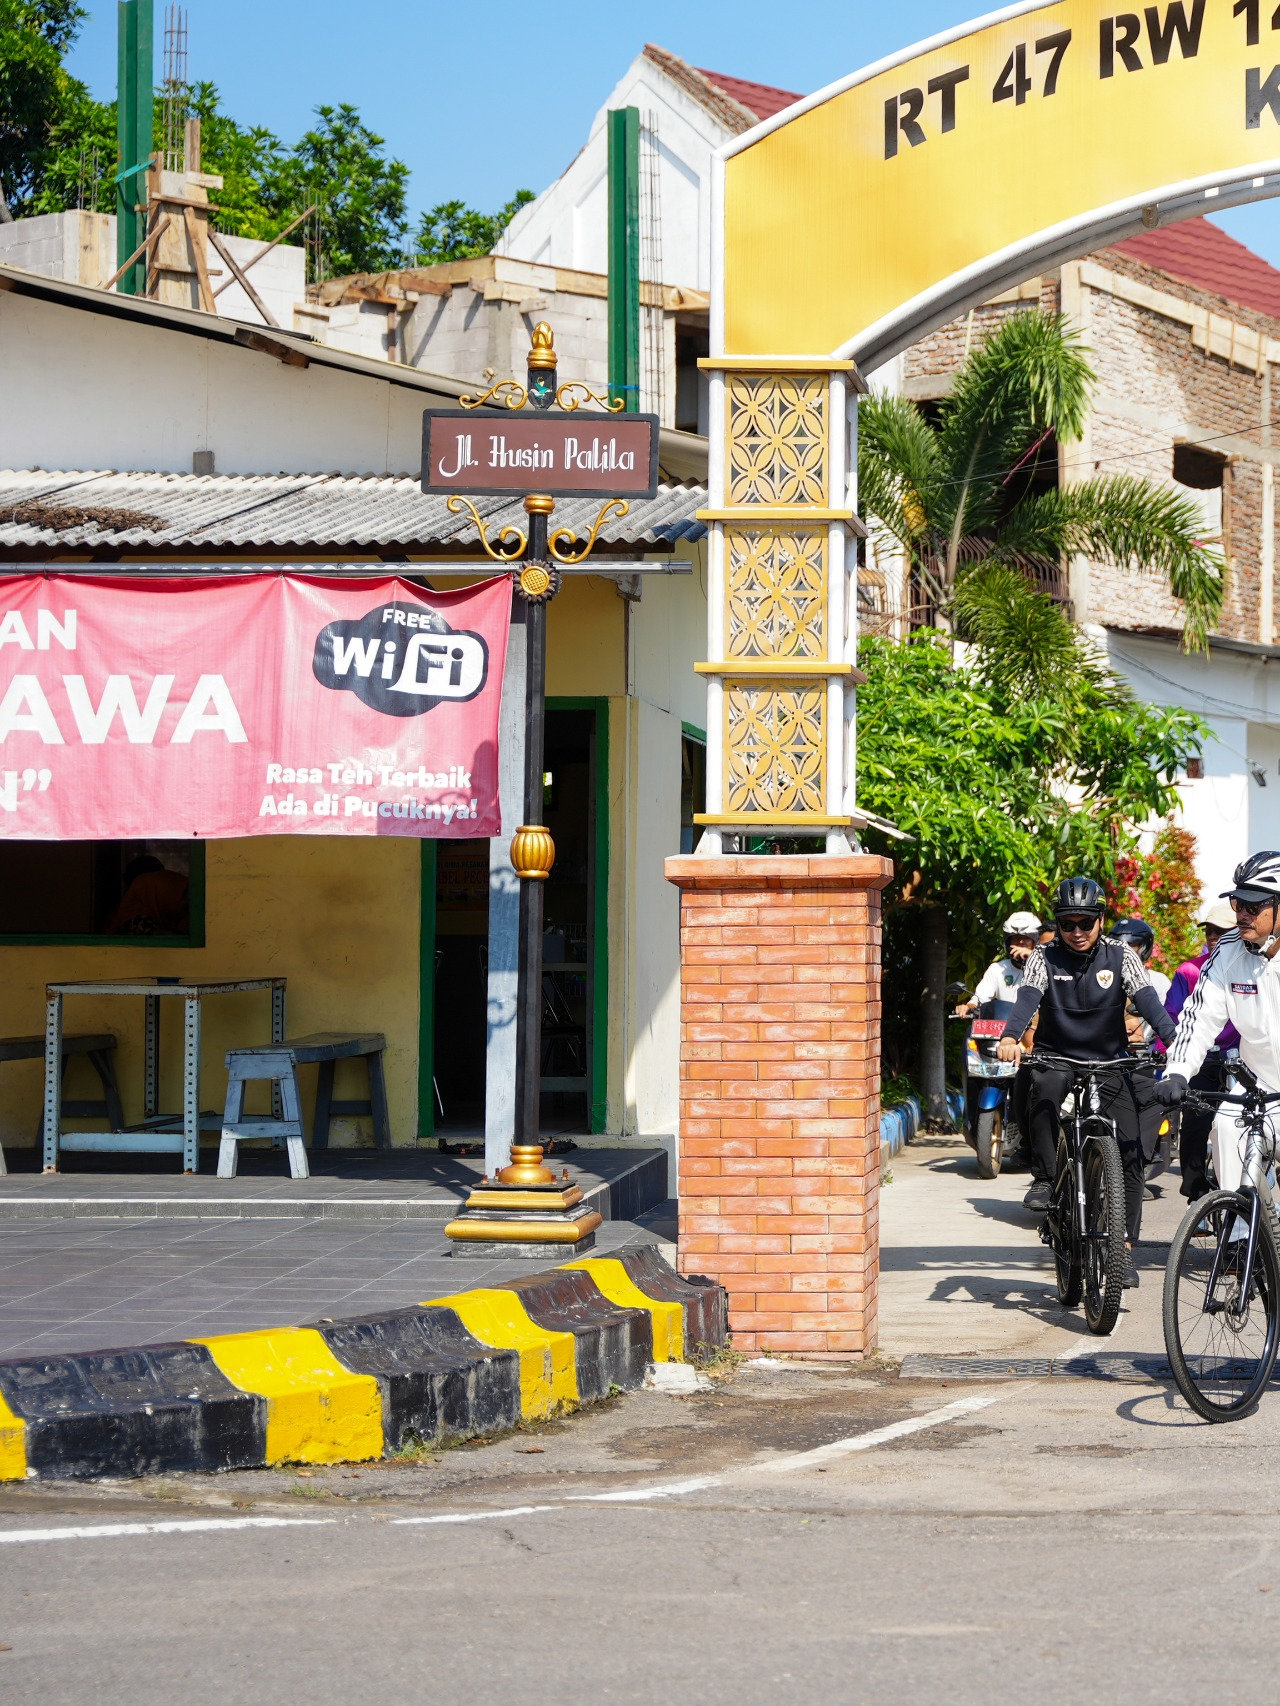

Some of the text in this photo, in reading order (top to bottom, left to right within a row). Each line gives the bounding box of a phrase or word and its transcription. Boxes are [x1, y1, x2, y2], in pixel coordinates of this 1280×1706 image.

[885, 65, 969, 160] RT
[992, 29, 1072, 106] 47
[1100, 0, 1205, 79] RW
[439, 434, 634, 477] Jl. Husin Palila
[0, 609, 77, 650] AN
[382, 609, 431, 629] FREE
[0, 674, 249, 744] AWA
[266, 763, 472, 788] Rasa Teh Terbaik
[259, 793, 478, 826] Ada di Pucuknya!
